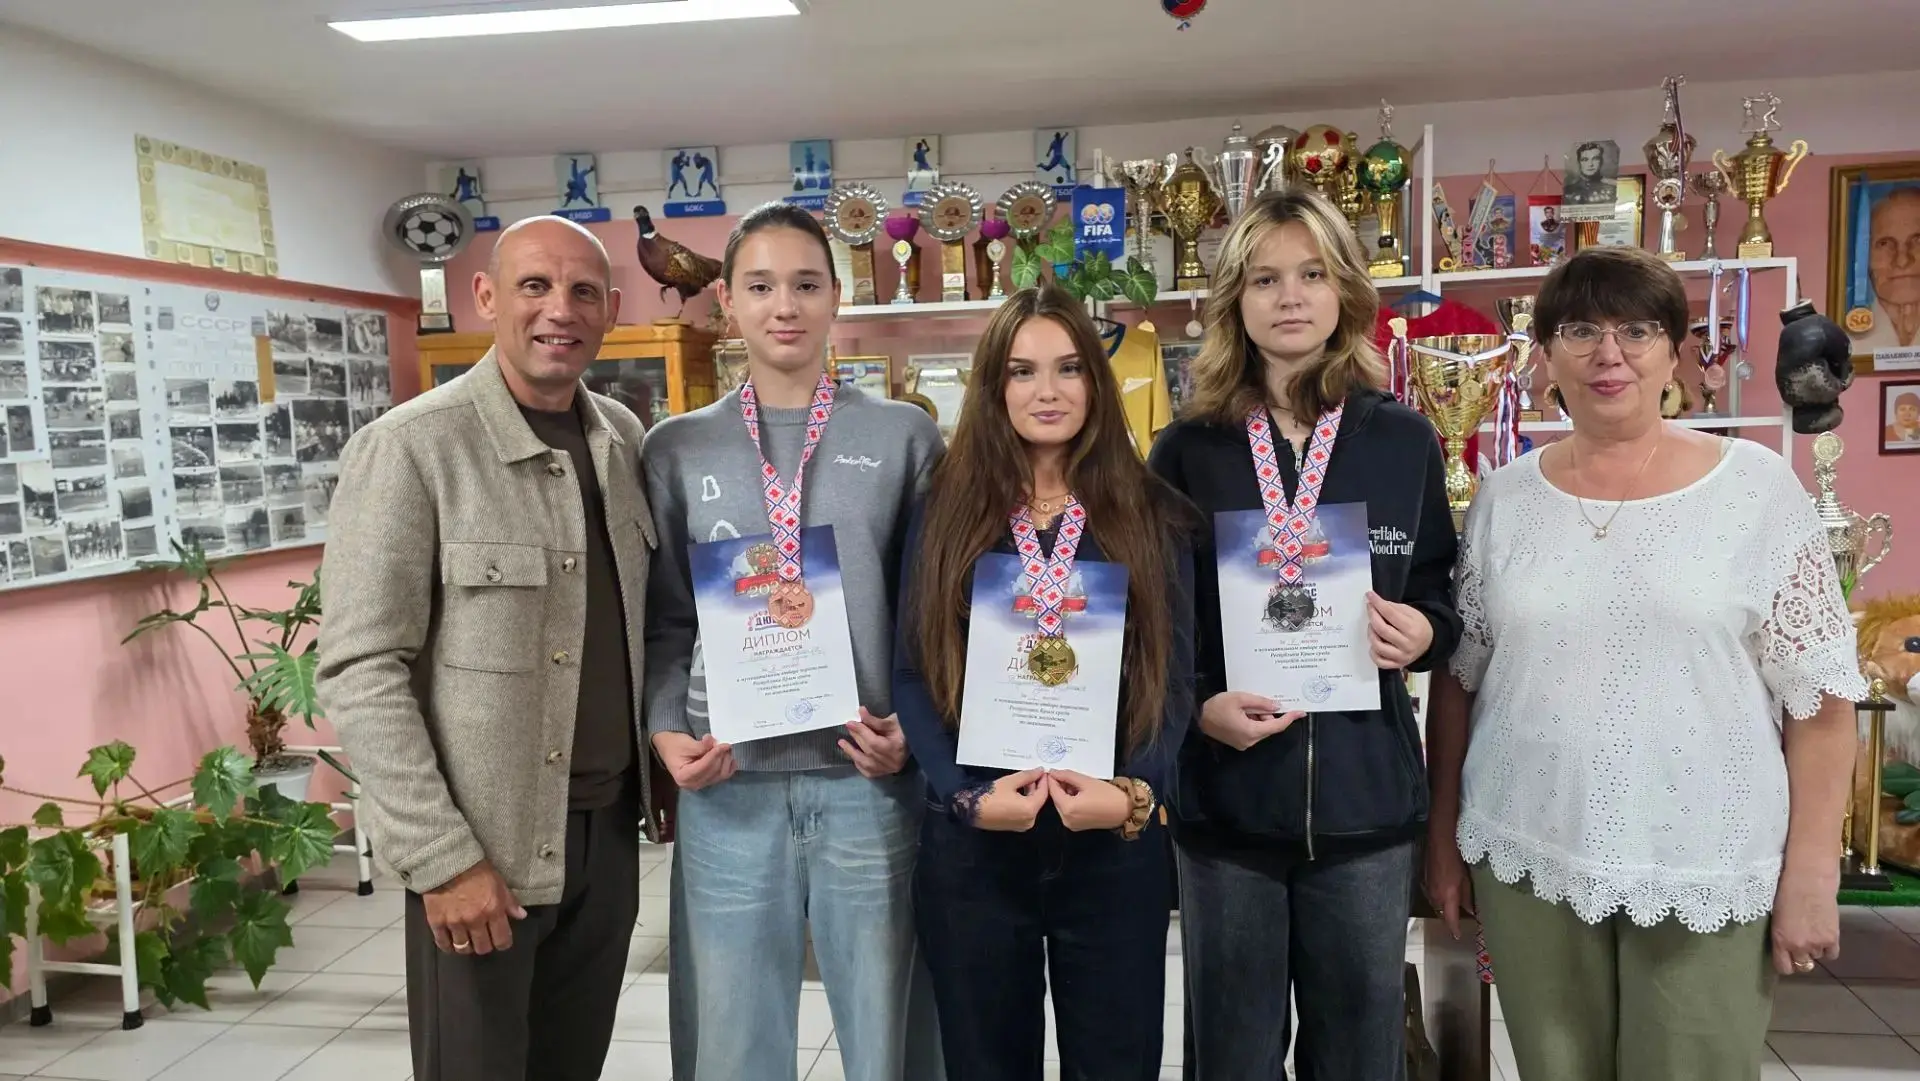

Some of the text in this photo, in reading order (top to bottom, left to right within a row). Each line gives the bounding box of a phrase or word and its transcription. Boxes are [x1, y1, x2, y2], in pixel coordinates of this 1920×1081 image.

[1083, 224, 1113, 236] FIFA
[181, 315, 247, 332] СССР
[1380, 526, 1402, 541] Hale
[743, 628, 811, 652] ДИПЛОМ
[753, 644, 803, 657] НАГРАЖДАЕТСЯ
